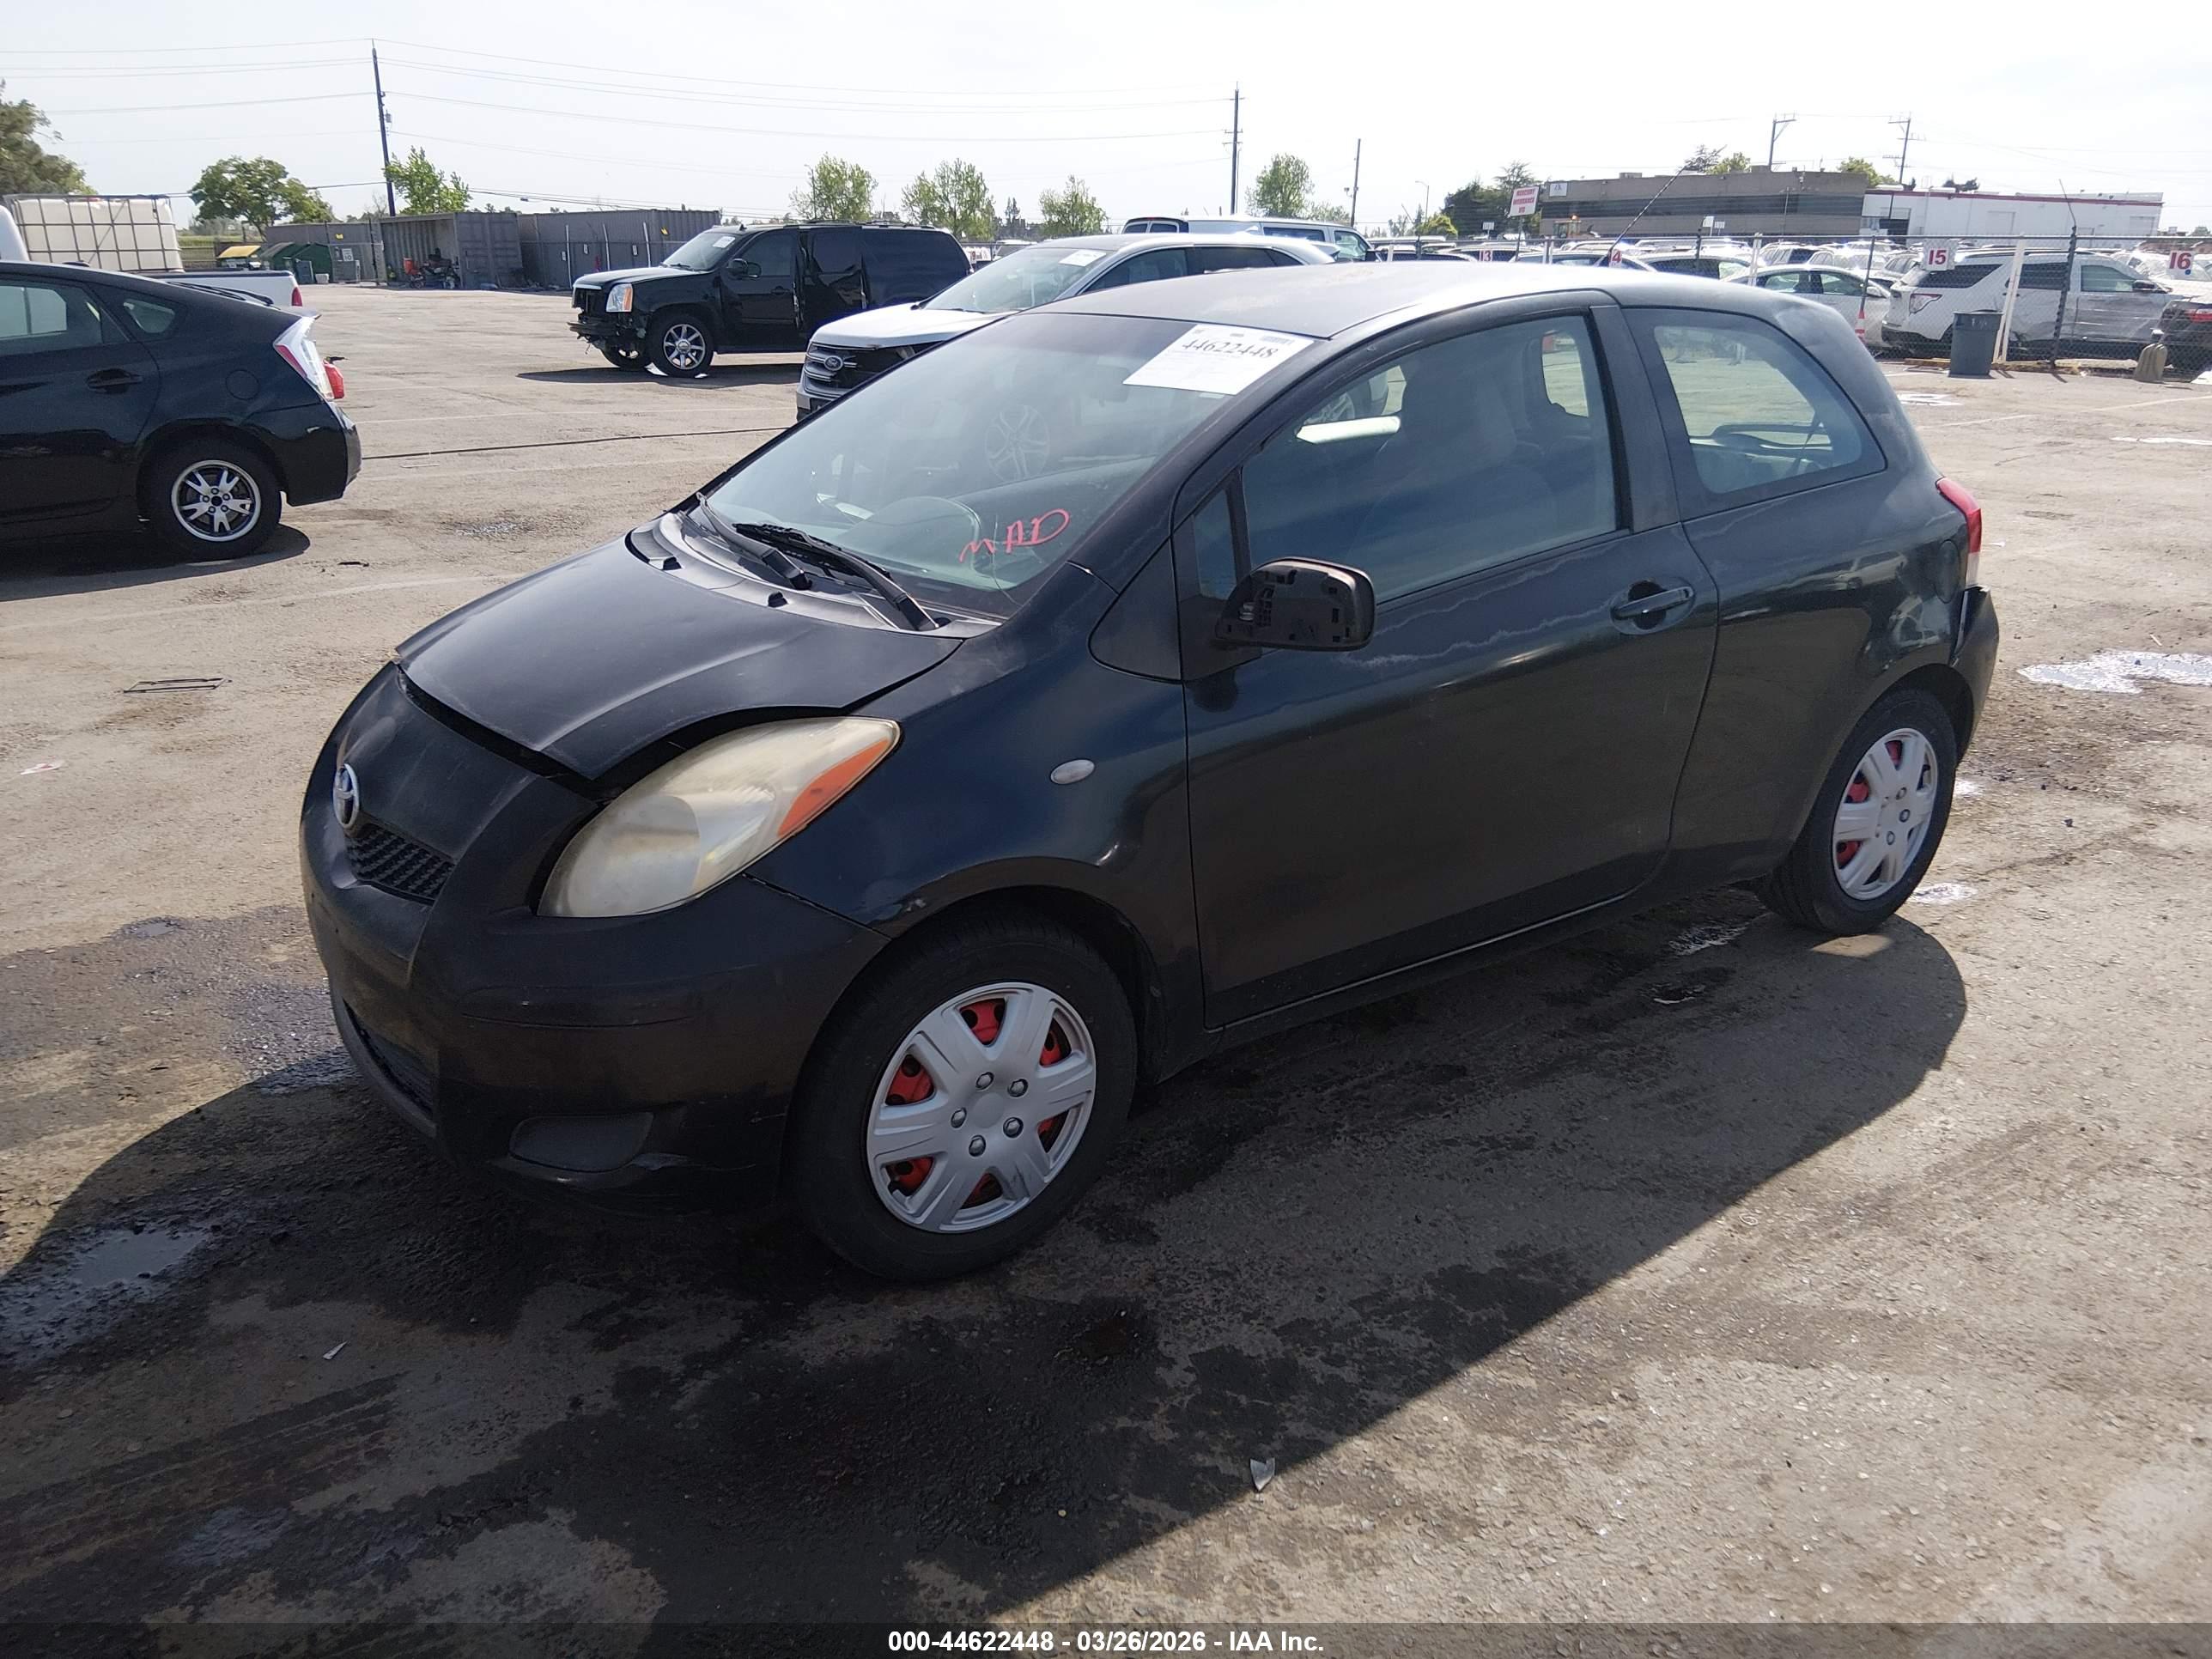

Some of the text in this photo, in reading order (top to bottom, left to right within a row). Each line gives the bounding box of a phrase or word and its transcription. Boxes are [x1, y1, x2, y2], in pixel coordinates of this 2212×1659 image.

[1480, 250, 1491, 262] 13
[1929, 249, 1948, 265] 15
[2169, 252, 2192, 270] 16
[1182, 339, 1279, 358] 44622448
